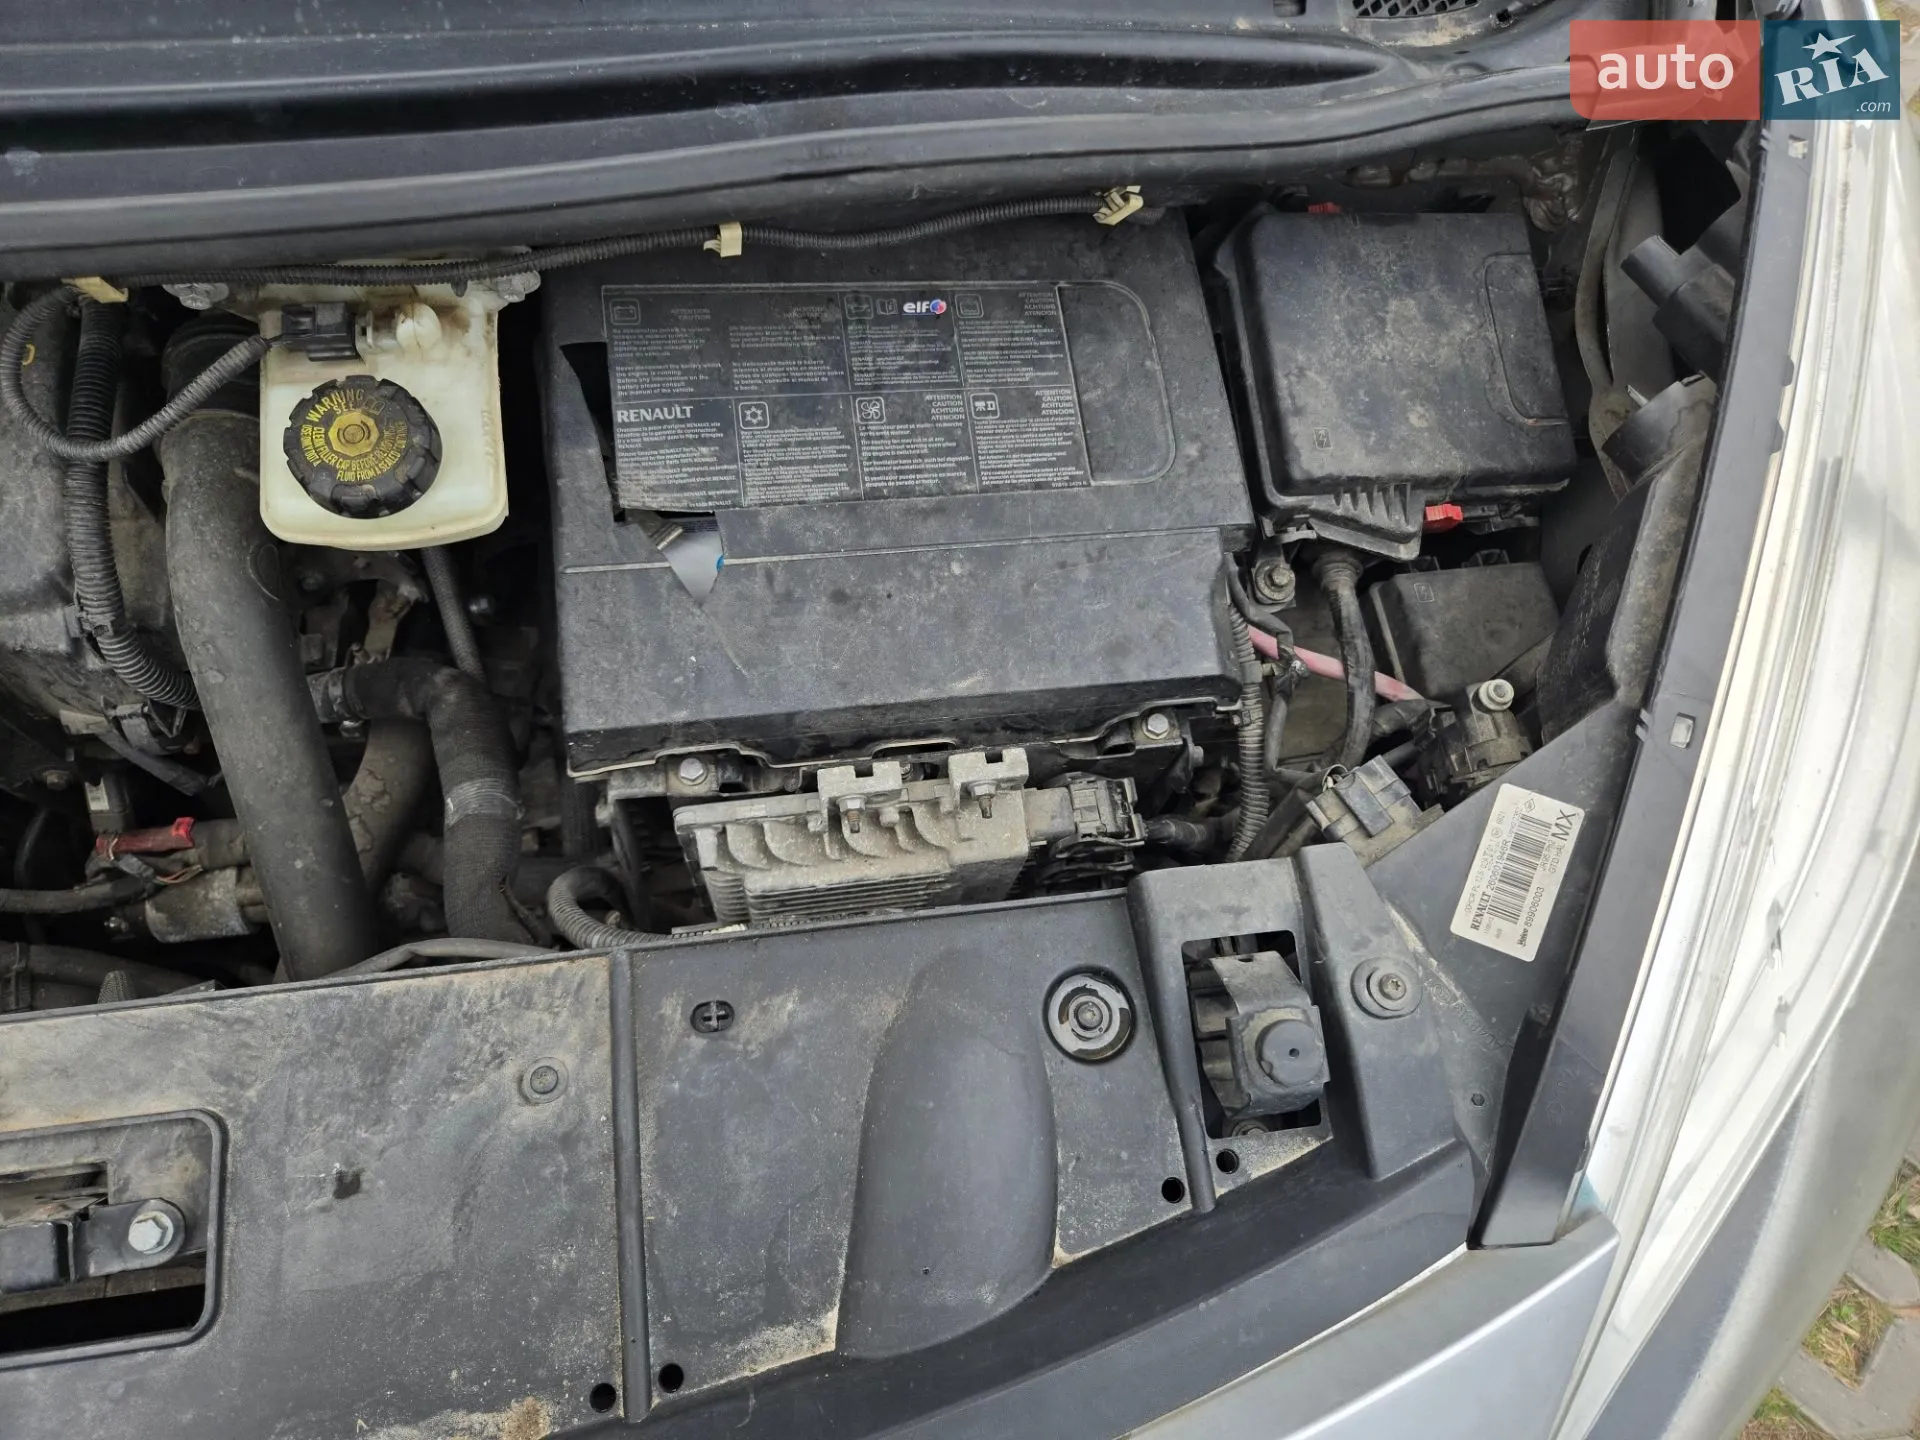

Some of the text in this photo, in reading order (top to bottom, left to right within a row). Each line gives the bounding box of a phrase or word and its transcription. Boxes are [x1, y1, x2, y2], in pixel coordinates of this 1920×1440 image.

[902, 300, 930, 313] elf
[306, 388, 365, 421] WARNING
[616, 406, 693, 423] RENAULT
[1550, 809, 1577, 841] MX
[1470, 892, 1491, 931] RENAULT
